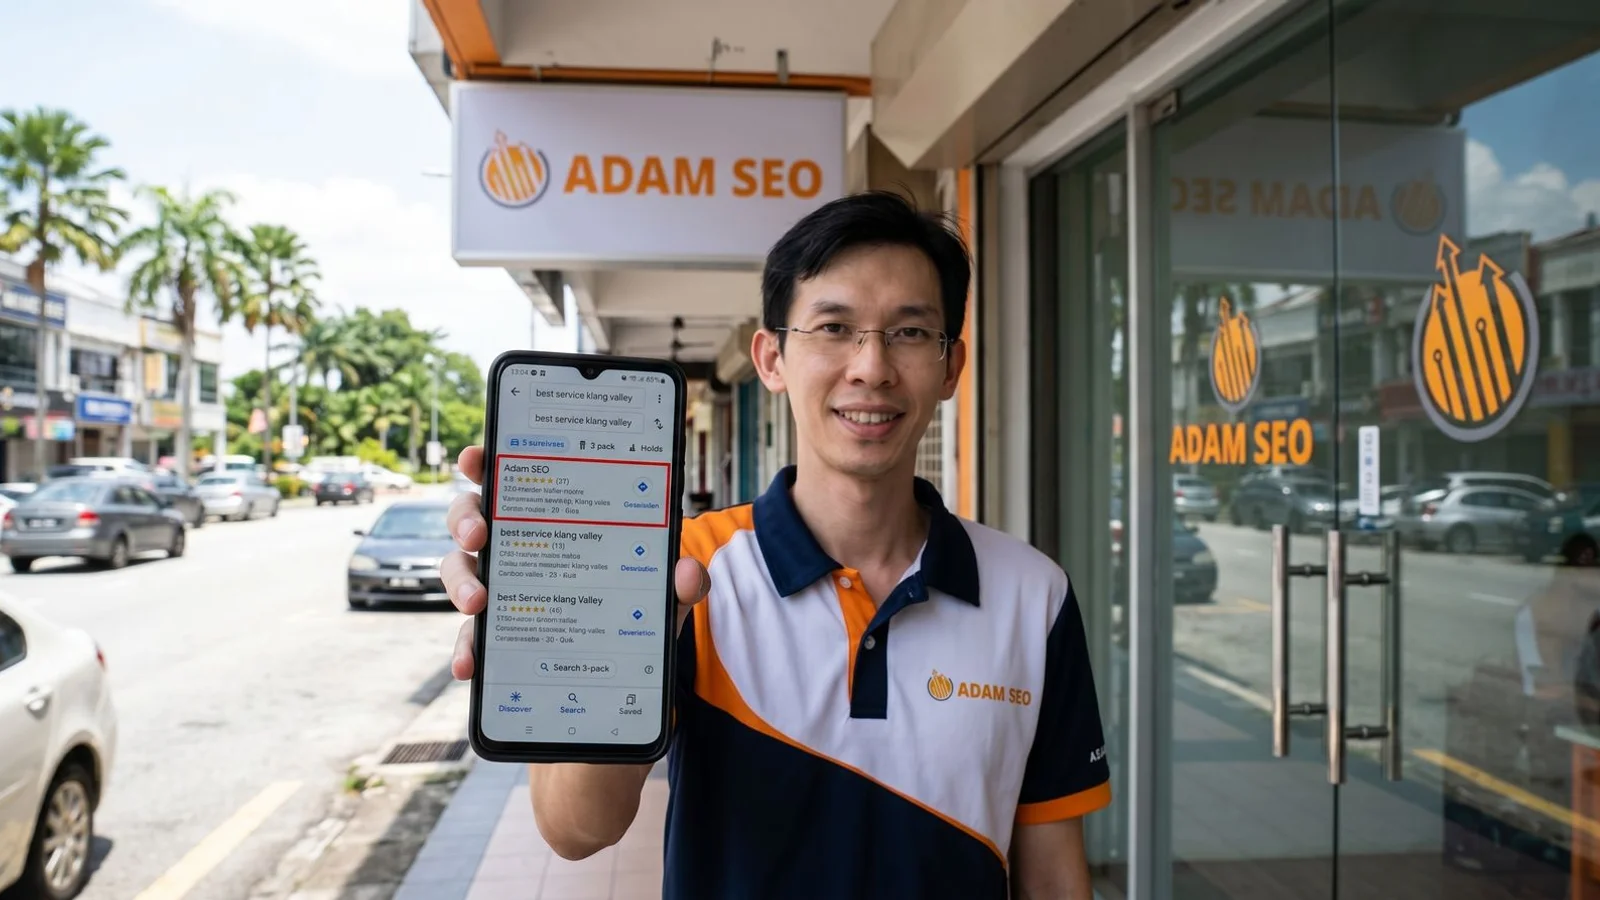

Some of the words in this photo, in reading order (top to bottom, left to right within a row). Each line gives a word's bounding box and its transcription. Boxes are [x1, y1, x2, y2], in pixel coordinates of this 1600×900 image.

[563, 154, 716, 197] ADAM
[731, 157, 824, 199] SEO
[536, 389, 554, 398] best
[556, 390, 585, 399] service
[586, 391, 608, 402] klang
[610, 393, 633, 403] valley
[535, 414, 553, 423] best
[555, 416, 584, 425] service
[585, 416, 608, 428] klang
[609, 418, 632, 428] valley
[597, 443, 615, 451] pack
[1169, 422, 1247, 465] ADAM
[1253, 418, 1314, 466] SEO
[640, 444, 663, 453] Holds
[504, 464, 529, 473] Adam
[531, 465, 550, 474] SEO
[503, 475, 514, 483] 4.8
[500, 528, 519, 537] best
[521, 529, 552, 538] service
[554, 530, 577, 541] klang
[579, 531, 603, 542] valley
[552, 542, 565, 550] (13)
[497, 593, 517, 602] best
[518, 593, 552, 603] Service
[553, 594, 577, 605] klang
[578, 595, 604, 606] Valley
[553, 663, 581, 672] Search
[582, 664, 610, 673] 3-pack
[957, 682, 1006, 702] ADAM
[1009, 688, 1032, 706] SEO
[498, 704, 533, 713] Discover
[560, 706, 586, 714] Search
[618, 707, 643, 715] Saved
